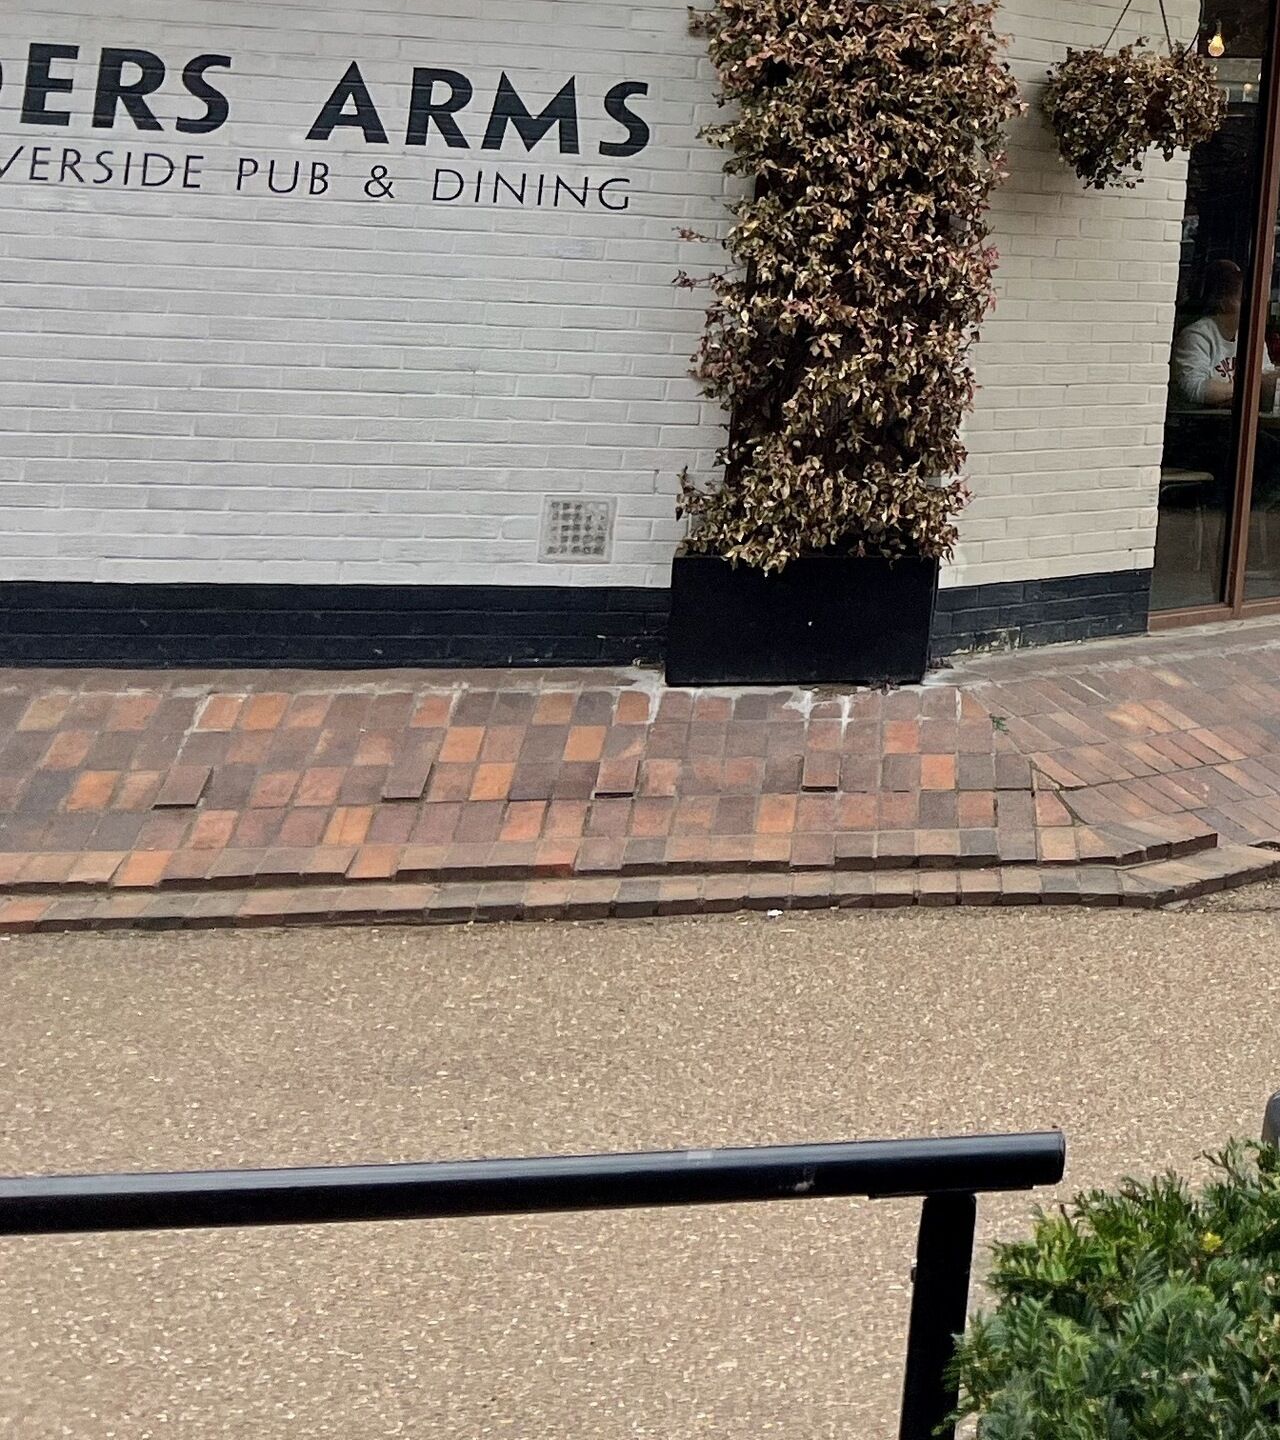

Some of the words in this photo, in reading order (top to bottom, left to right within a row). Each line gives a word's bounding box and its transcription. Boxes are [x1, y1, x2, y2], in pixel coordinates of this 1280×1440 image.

[0, 42, 232, 135] ERS
[305, 60, 651, 158] ARMS
[236, 157, 329, 196] PUB
[364, 164, 395, 199] &
[432, 168, 631, 211] DINING
